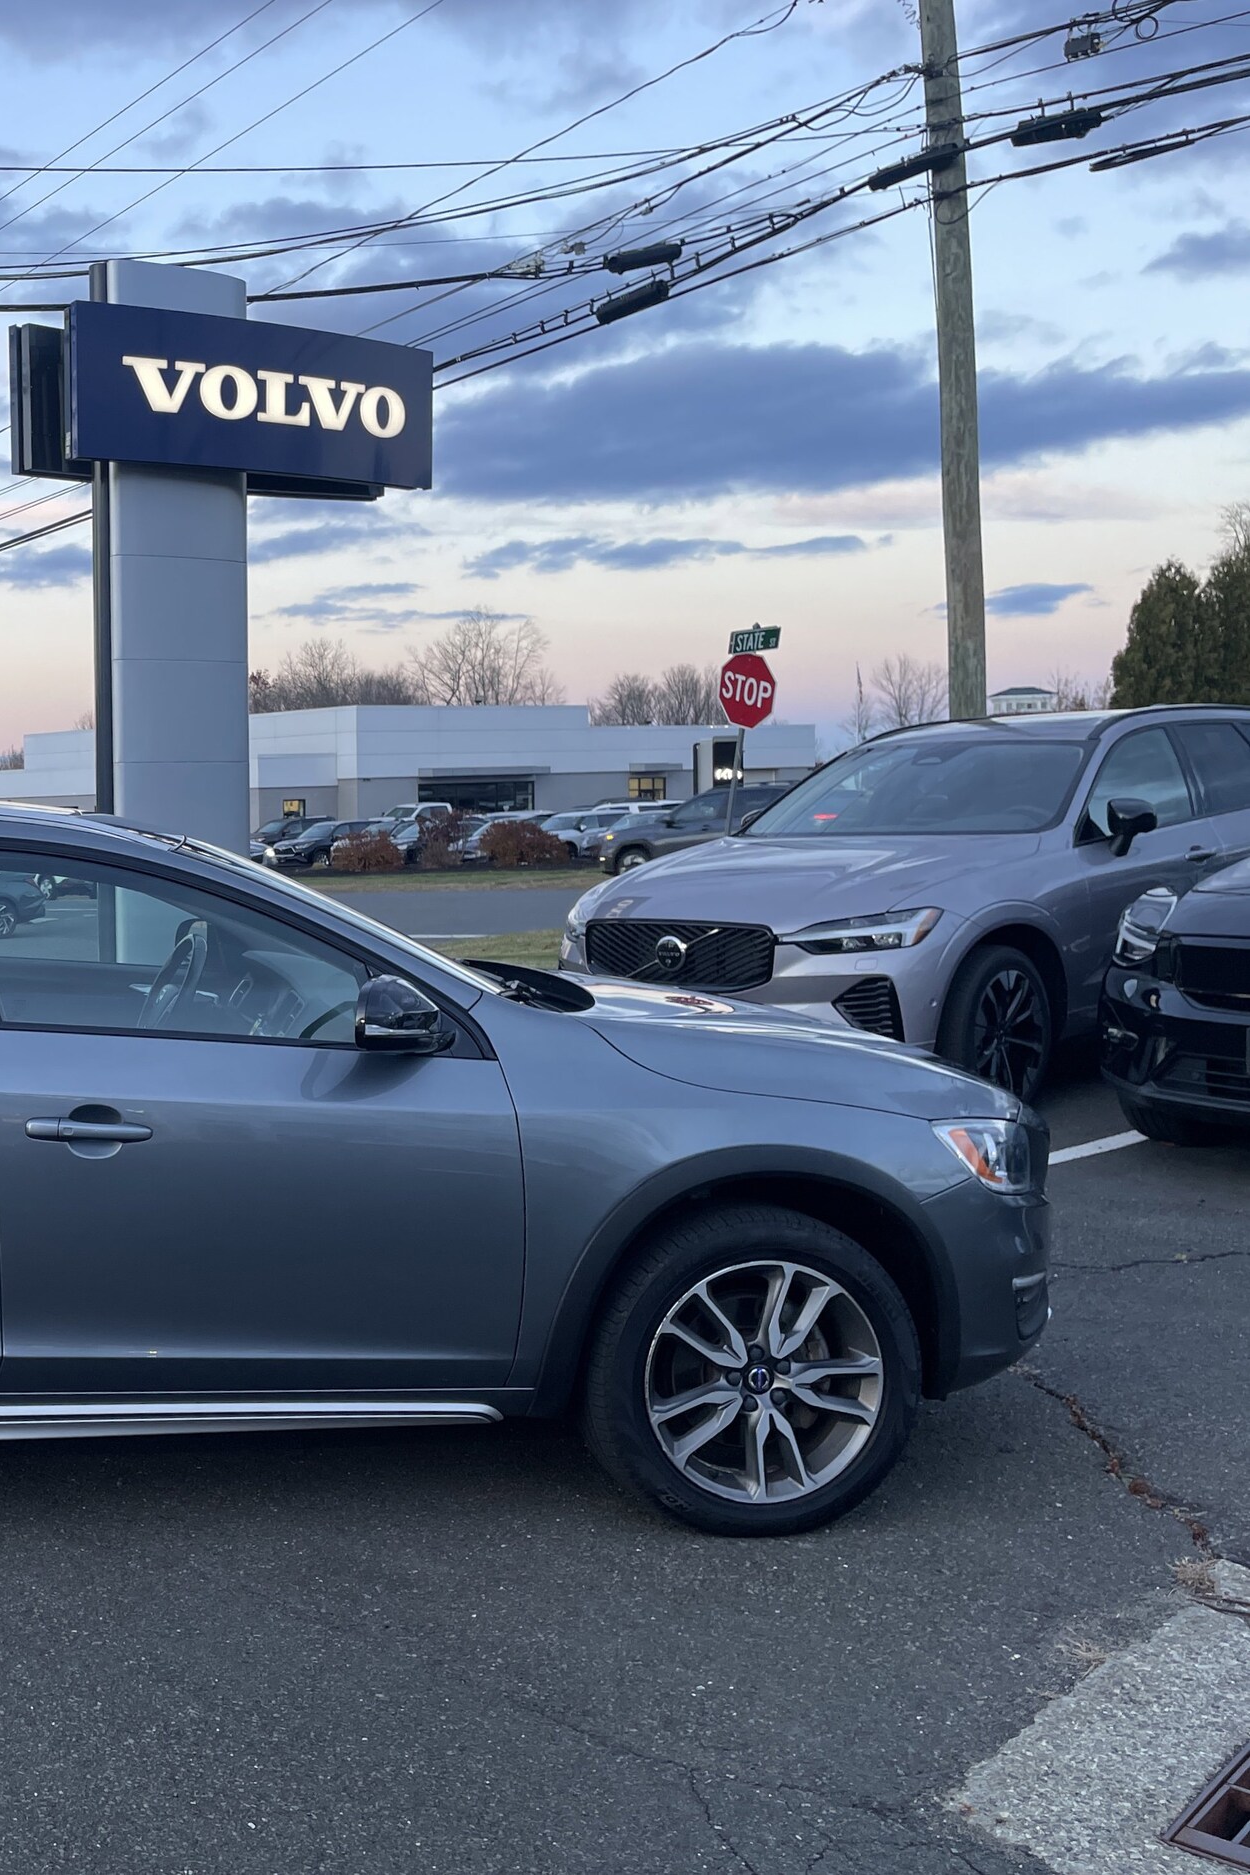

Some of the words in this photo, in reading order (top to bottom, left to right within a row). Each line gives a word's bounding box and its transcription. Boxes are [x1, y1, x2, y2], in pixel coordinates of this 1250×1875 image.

[122, 355, 406, 439] VOLVO
[736, 631, 766, 652] STATE
[722, 671, 772, 709] STOP
